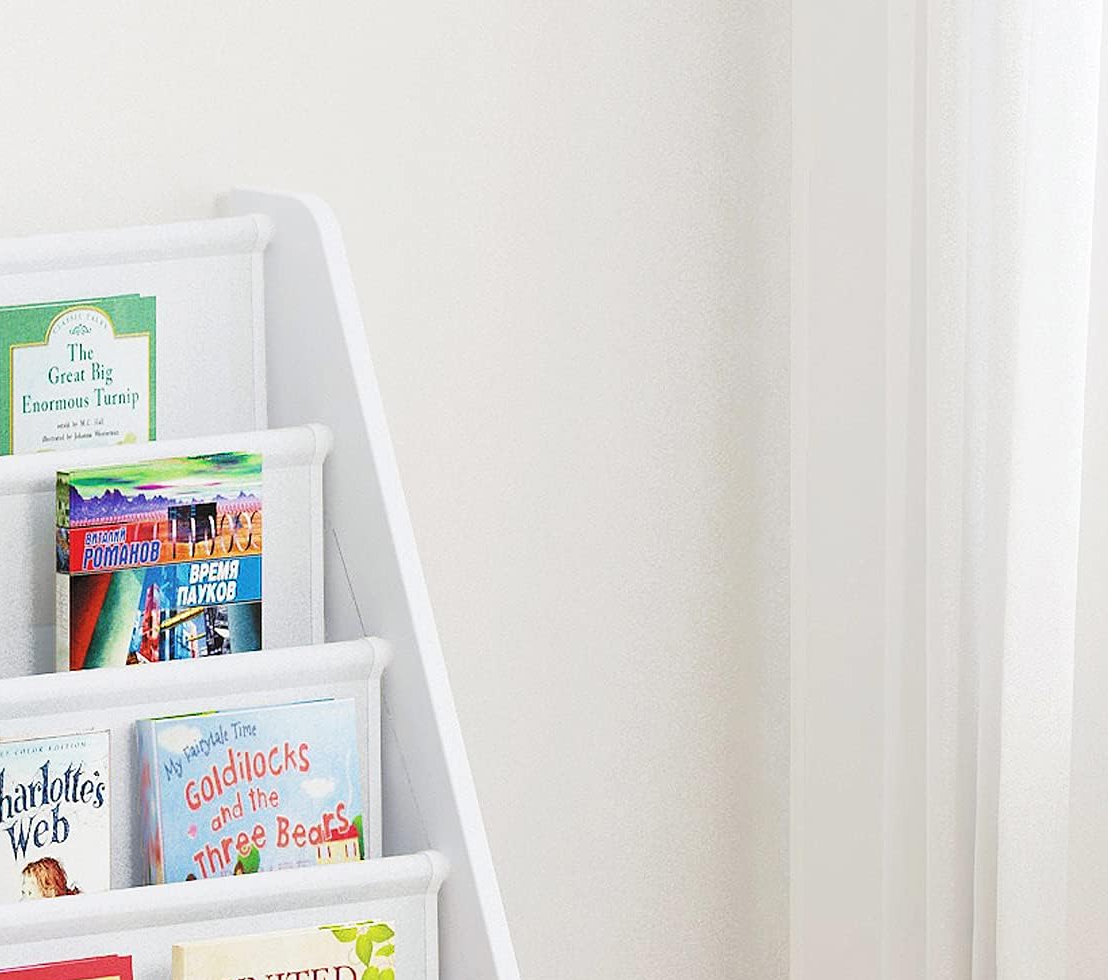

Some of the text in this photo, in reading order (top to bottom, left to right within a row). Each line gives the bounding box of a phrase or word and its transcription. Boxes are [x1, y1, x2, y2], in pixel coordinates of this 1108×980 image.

[67, 343, 94, 362] The
[48, 363, 113, 385] Great Big
[22, 388, 140, 414] Enormous Turnip
[83, 541, 161, 570] РОМАНОВ
[190, 560, 239, 584] ВРЕМЯ
[177, 581, 237, 607] ПАУКОВ
[163, 721, 257, 781] My Fairytale Time
[185, 741, 310, 811] Goldilocks
[211, 787, 279, 832] and the
[7, 801, 70, 862] Web
[194, 802, 349, 879] Three Bears
